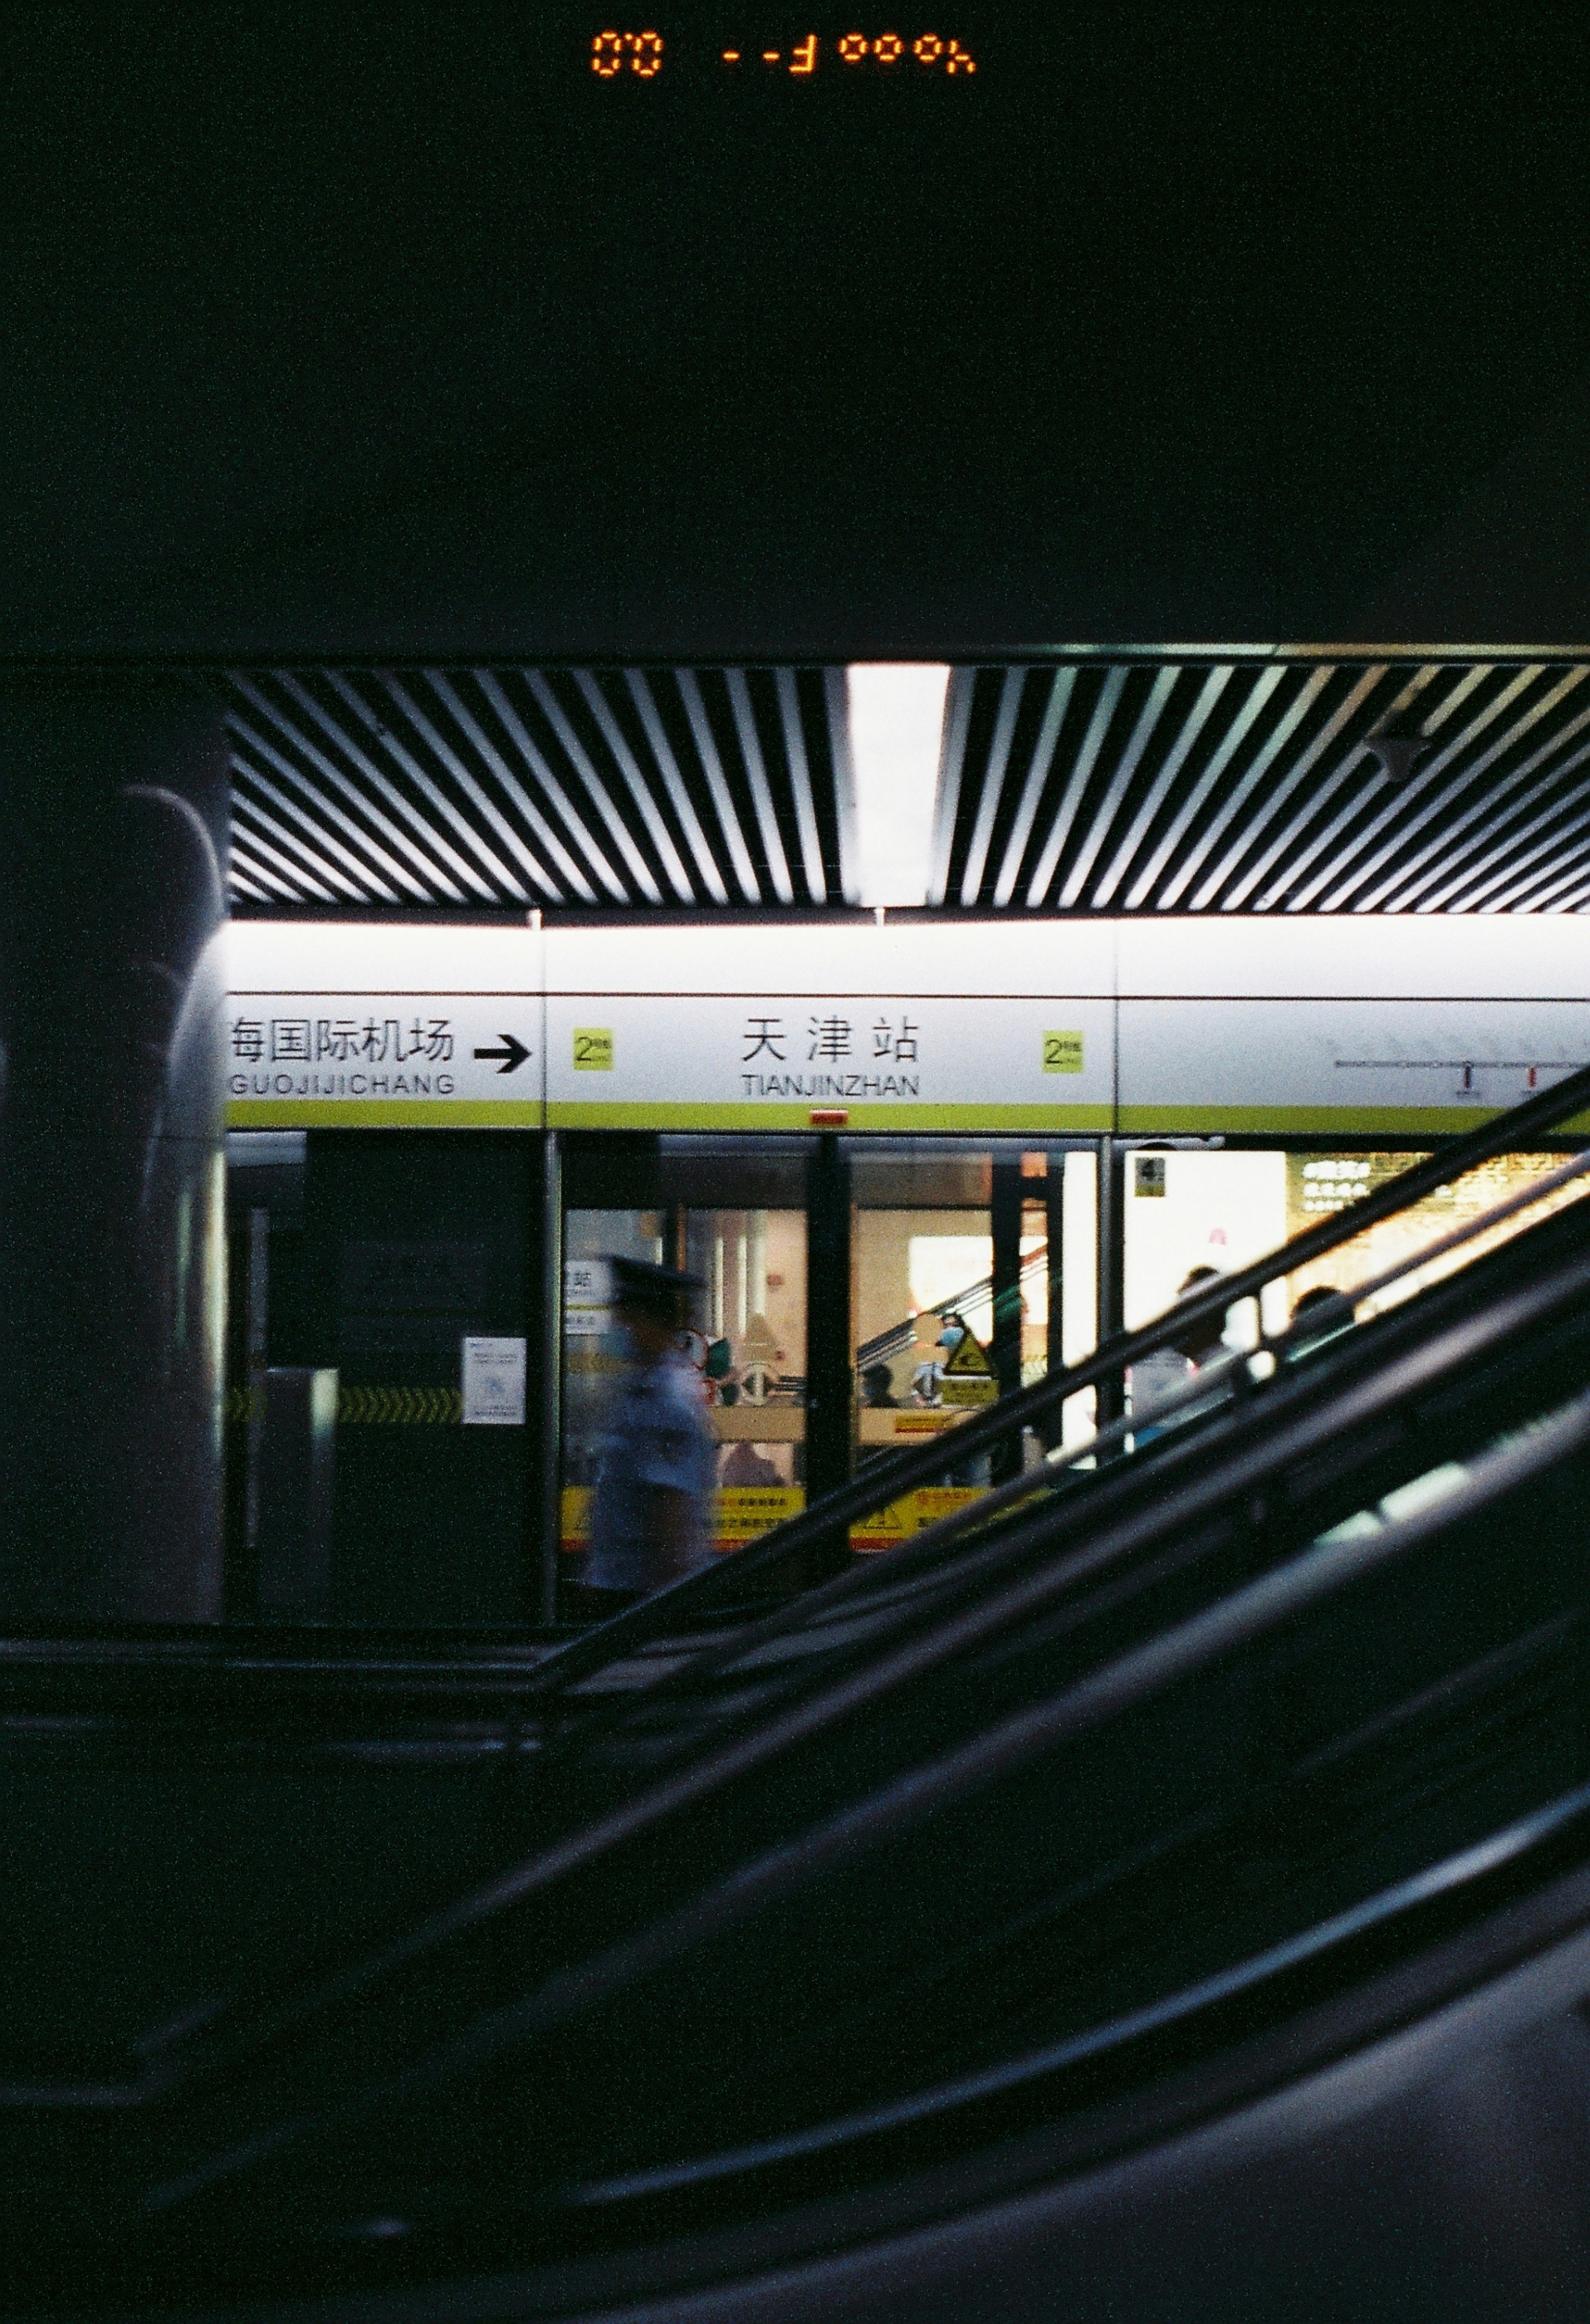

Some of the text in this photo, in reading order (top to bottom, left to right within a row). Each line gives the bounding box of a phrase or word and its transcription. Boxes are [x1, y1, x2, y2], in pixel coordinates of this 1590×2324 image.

[741, 1015, 920, 1063] 天津站
[741, 1074, 920, 1096] TIANJINZHAN
